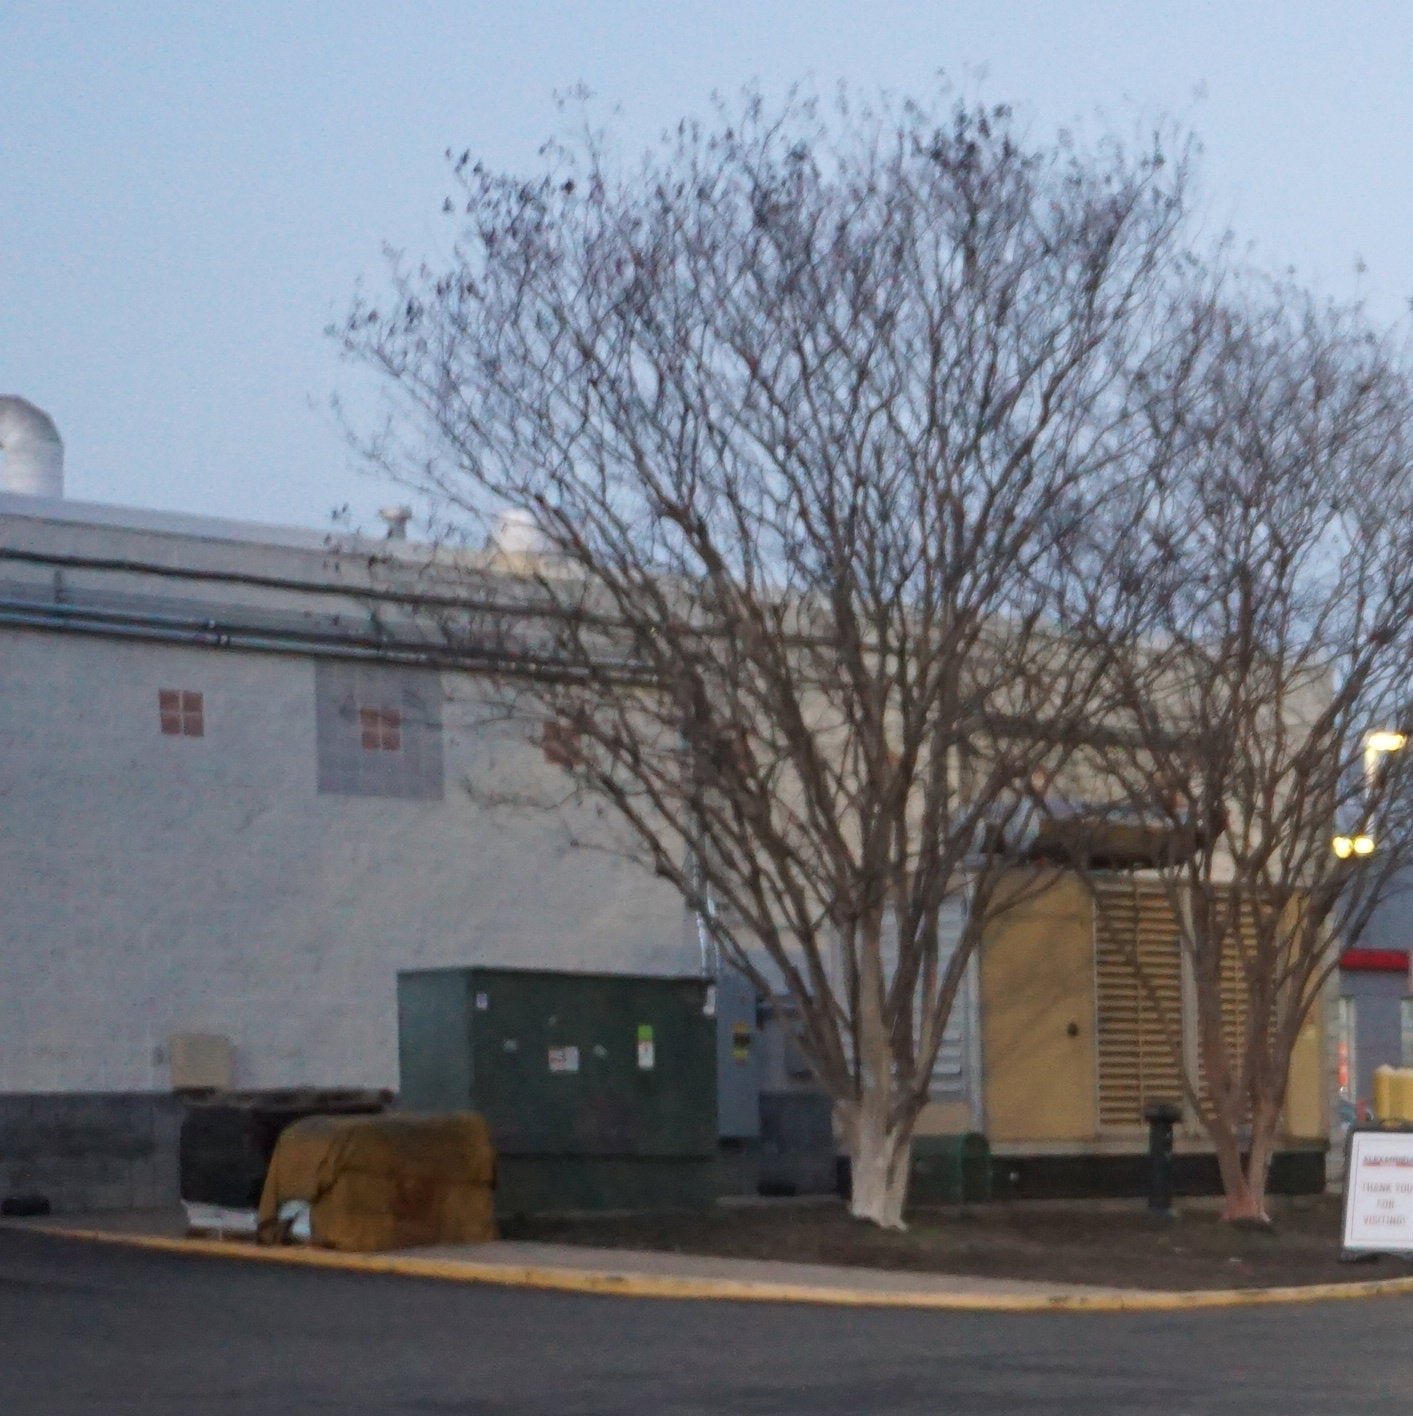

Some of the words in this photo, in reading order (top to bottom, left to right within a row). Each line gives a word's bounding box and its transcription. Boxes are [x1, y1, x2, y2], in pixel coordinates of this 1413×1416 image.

[1363, 1182, 1392, 1194] THANK
[1395, 1182, 1413, 1194] YOU
[1376, 1198, 1396, 1209] FOR
